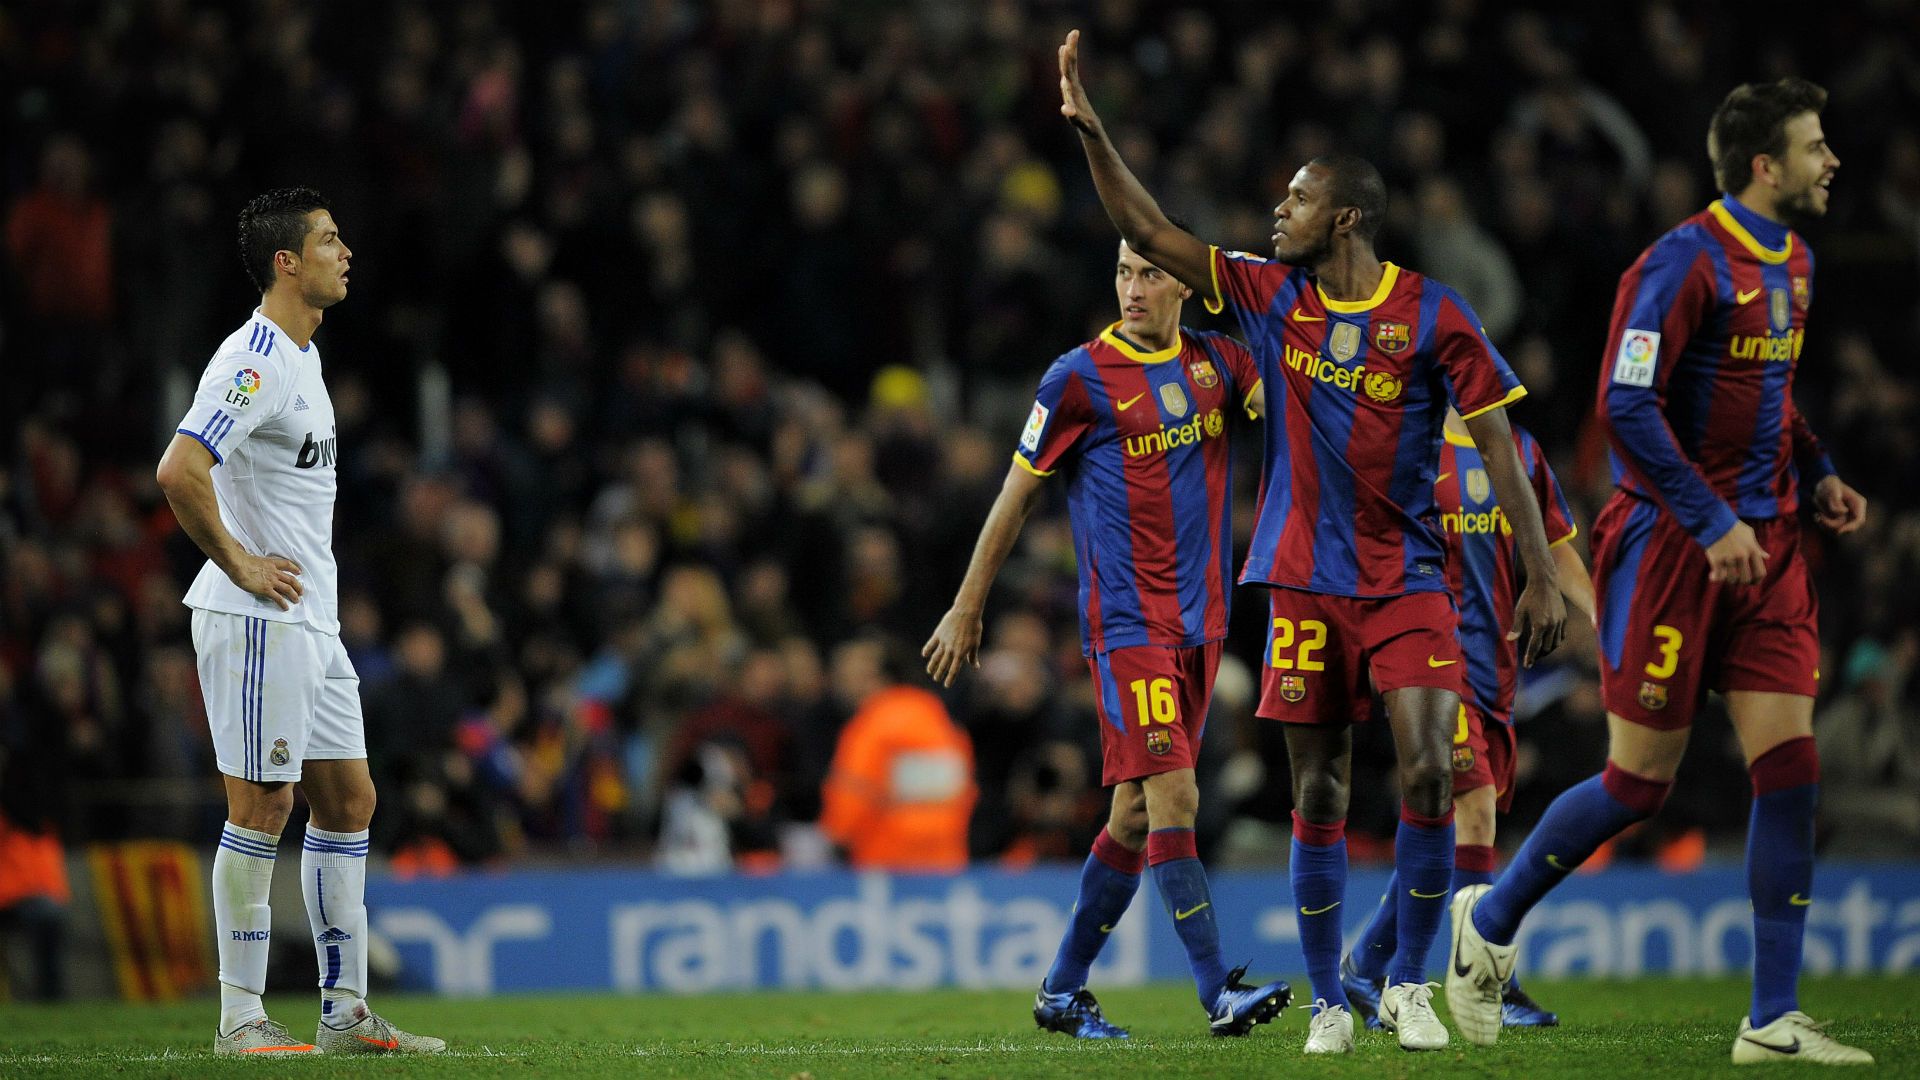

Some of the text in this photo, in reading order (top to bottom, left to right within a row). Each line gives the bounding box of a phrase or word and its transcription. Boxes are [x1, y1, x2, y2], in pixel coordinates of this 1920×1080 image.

[1730, 328, 1794, 361] unicef
[1285, 344, 1366, 392] unicef
[1620, 364, 1649, 381] LFP
[225, 389, 250, 408] LFP
[1126, 413, 1202, 457] unicef
[1441, 505, 1501, 534] nicef
[1271, 617, 1328, 672] 22
[1645, 624, 1684, 680] 3
[1130, 677, 1177, 727] 16
[611, 872, 1147, 990] randstad
